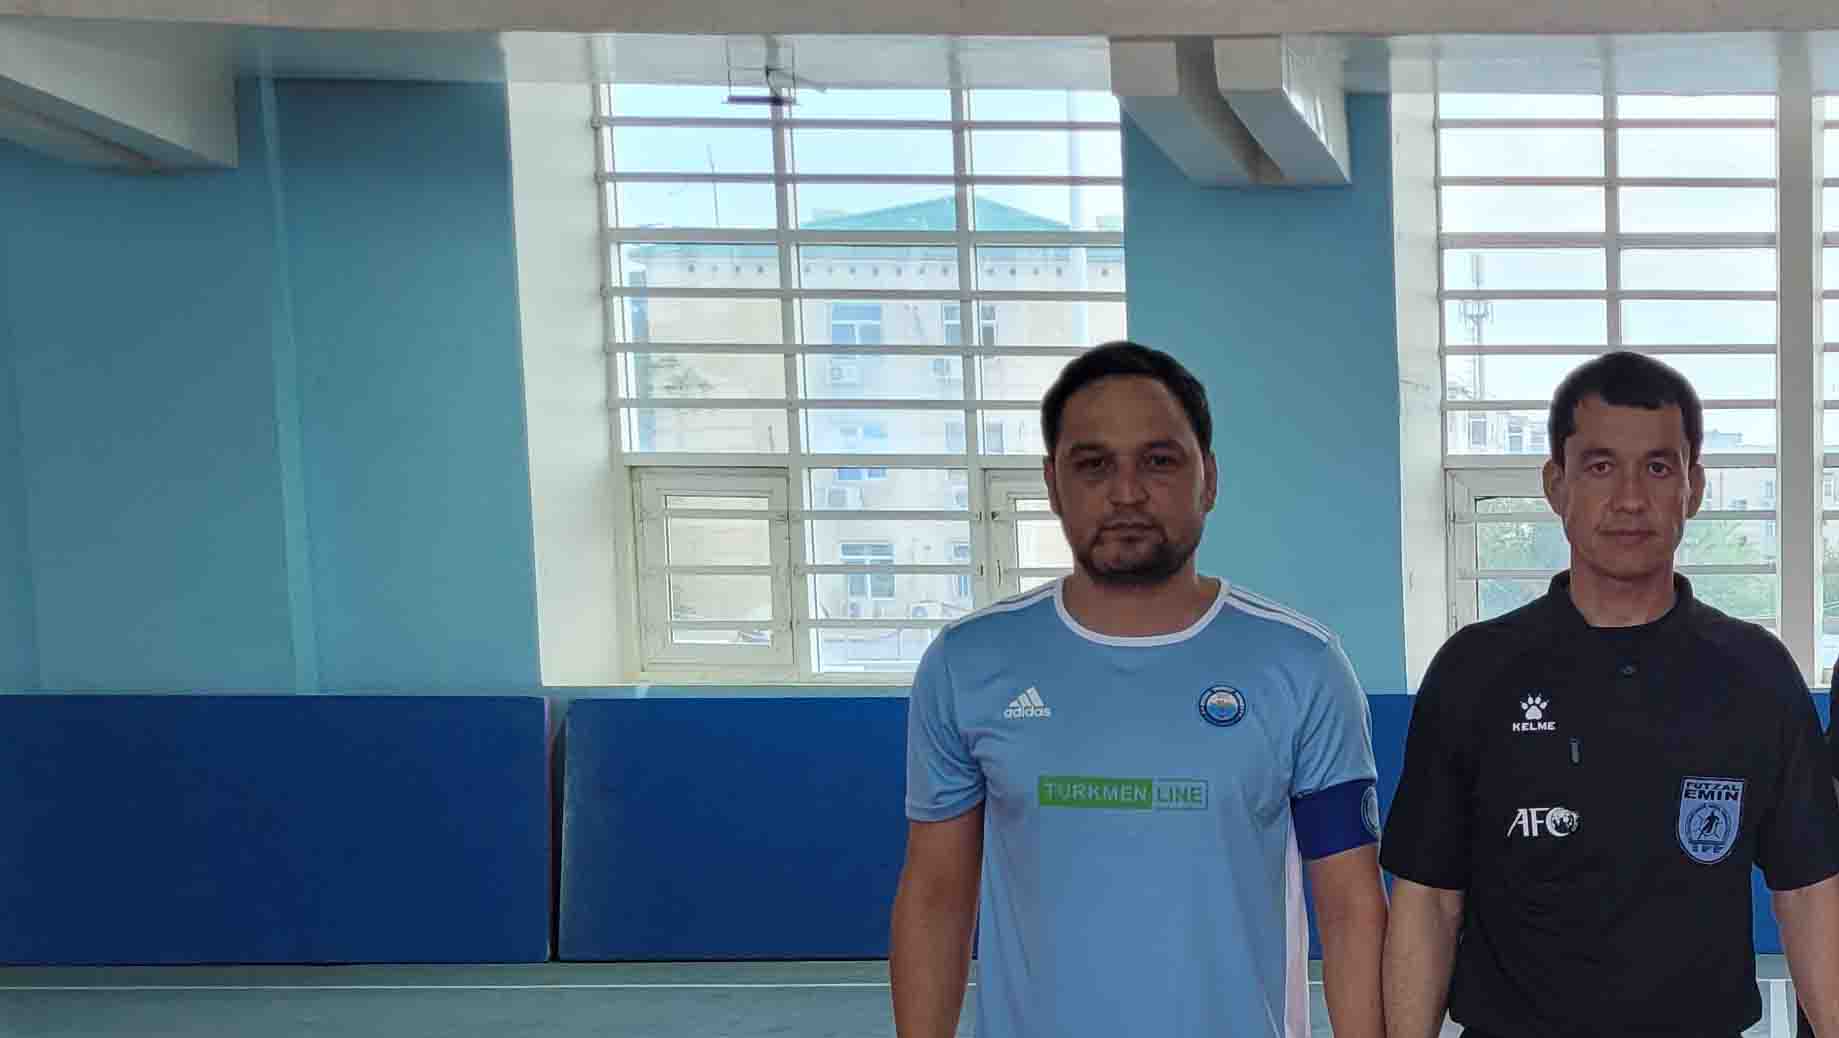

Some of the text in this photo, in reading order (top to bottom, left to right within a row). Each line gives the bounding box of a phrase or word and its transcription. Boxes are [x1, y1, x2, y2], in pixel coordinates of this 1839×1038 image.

[1003, 705, 1051, 719] adidas
[1512, 721, 1556, 732] KELME
[1043, 782, 1202, 803] TURKMEN LINE
[1684, 790, 1739, 801] EMIN
[1507, 807, 1579, 838] AFC
